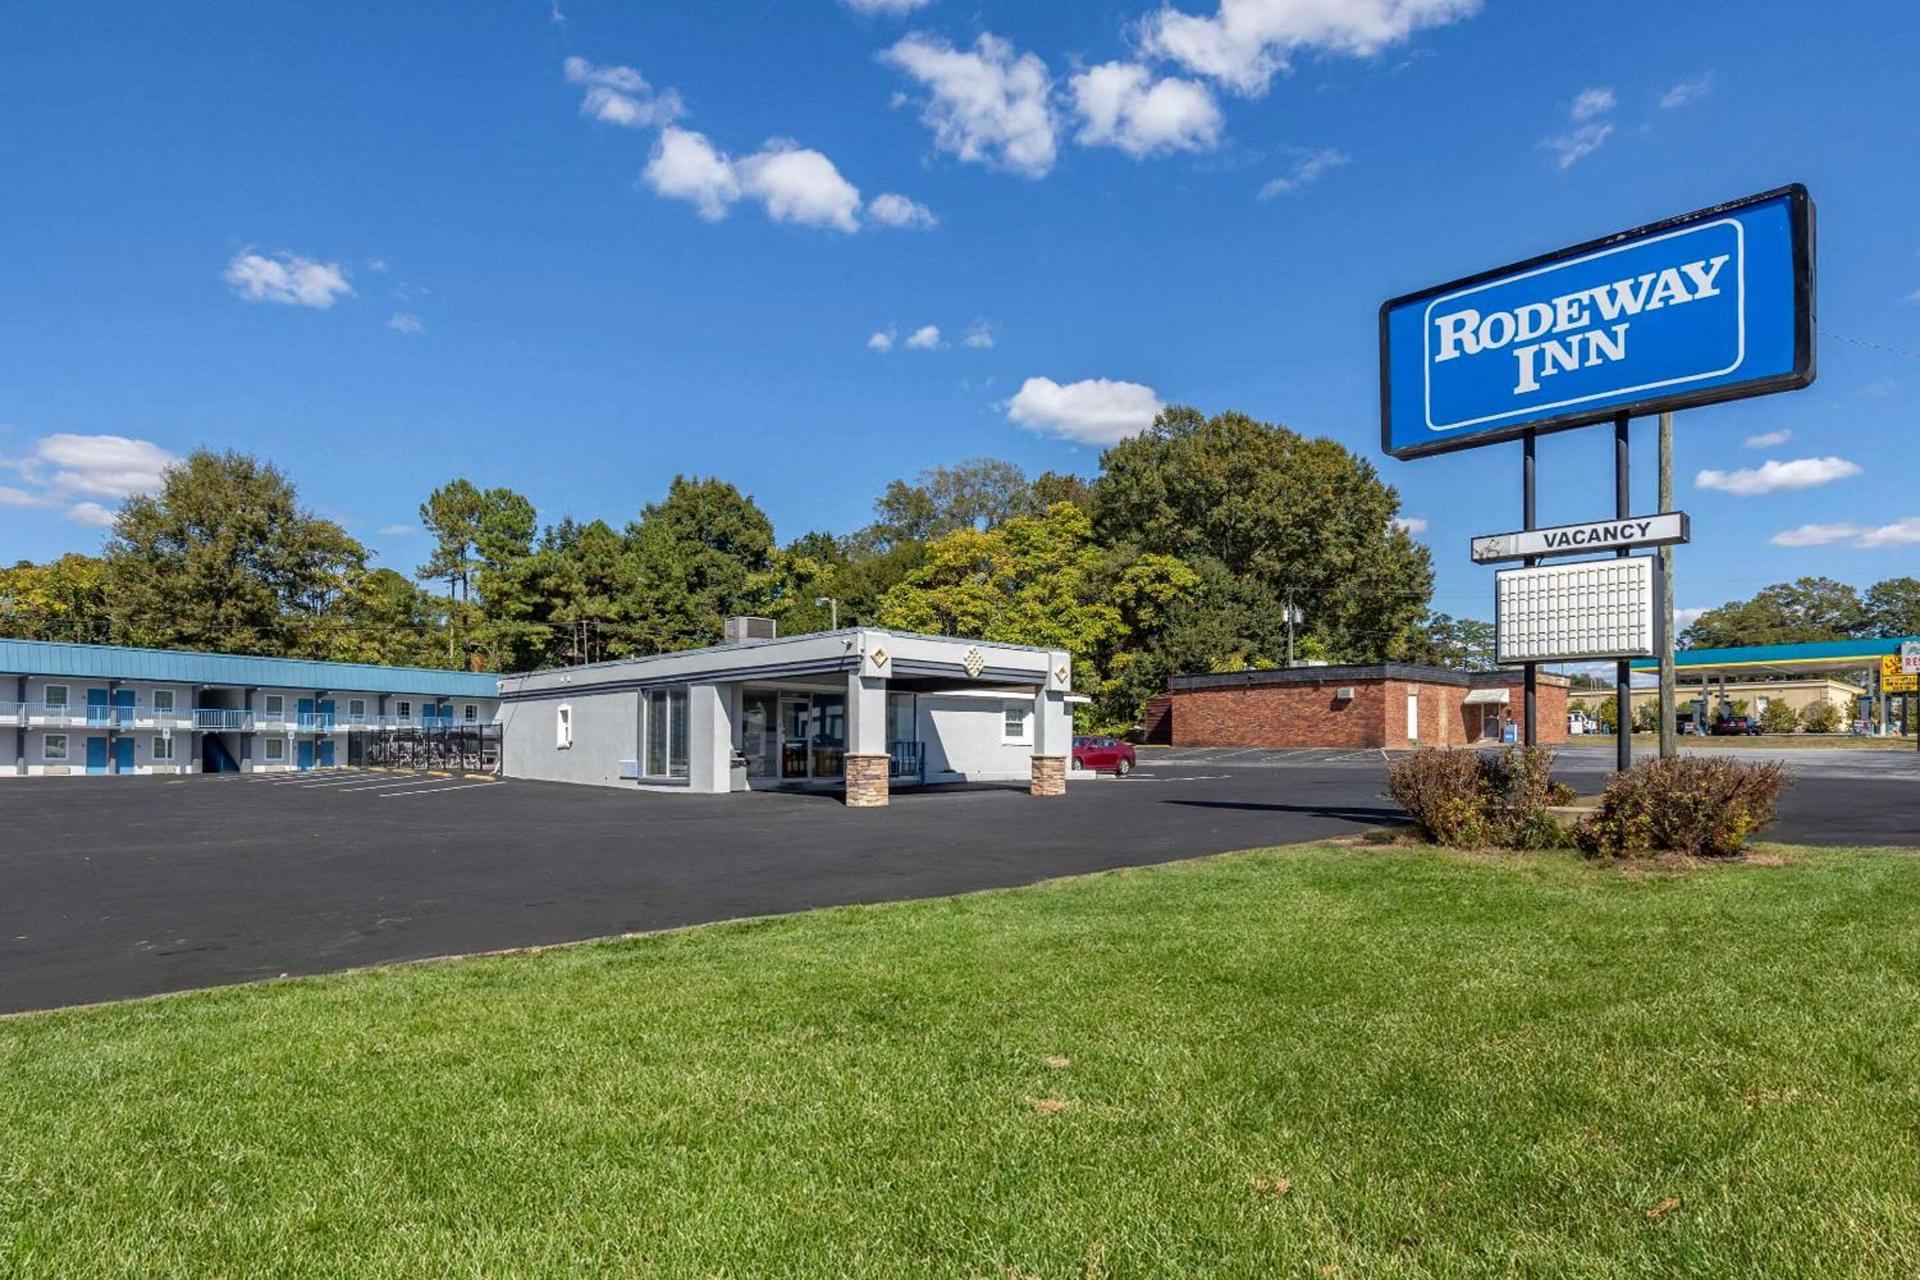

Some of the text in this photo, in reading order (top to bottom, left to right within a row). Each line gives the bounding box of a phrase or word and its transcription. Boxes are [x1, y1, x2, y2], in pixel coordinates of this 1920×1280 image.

[1434, 254, 1730, 363] RODEWAY
[1513, 322, 1630, 395] INN
[1543, 521, 1652, 549] VACANCY
